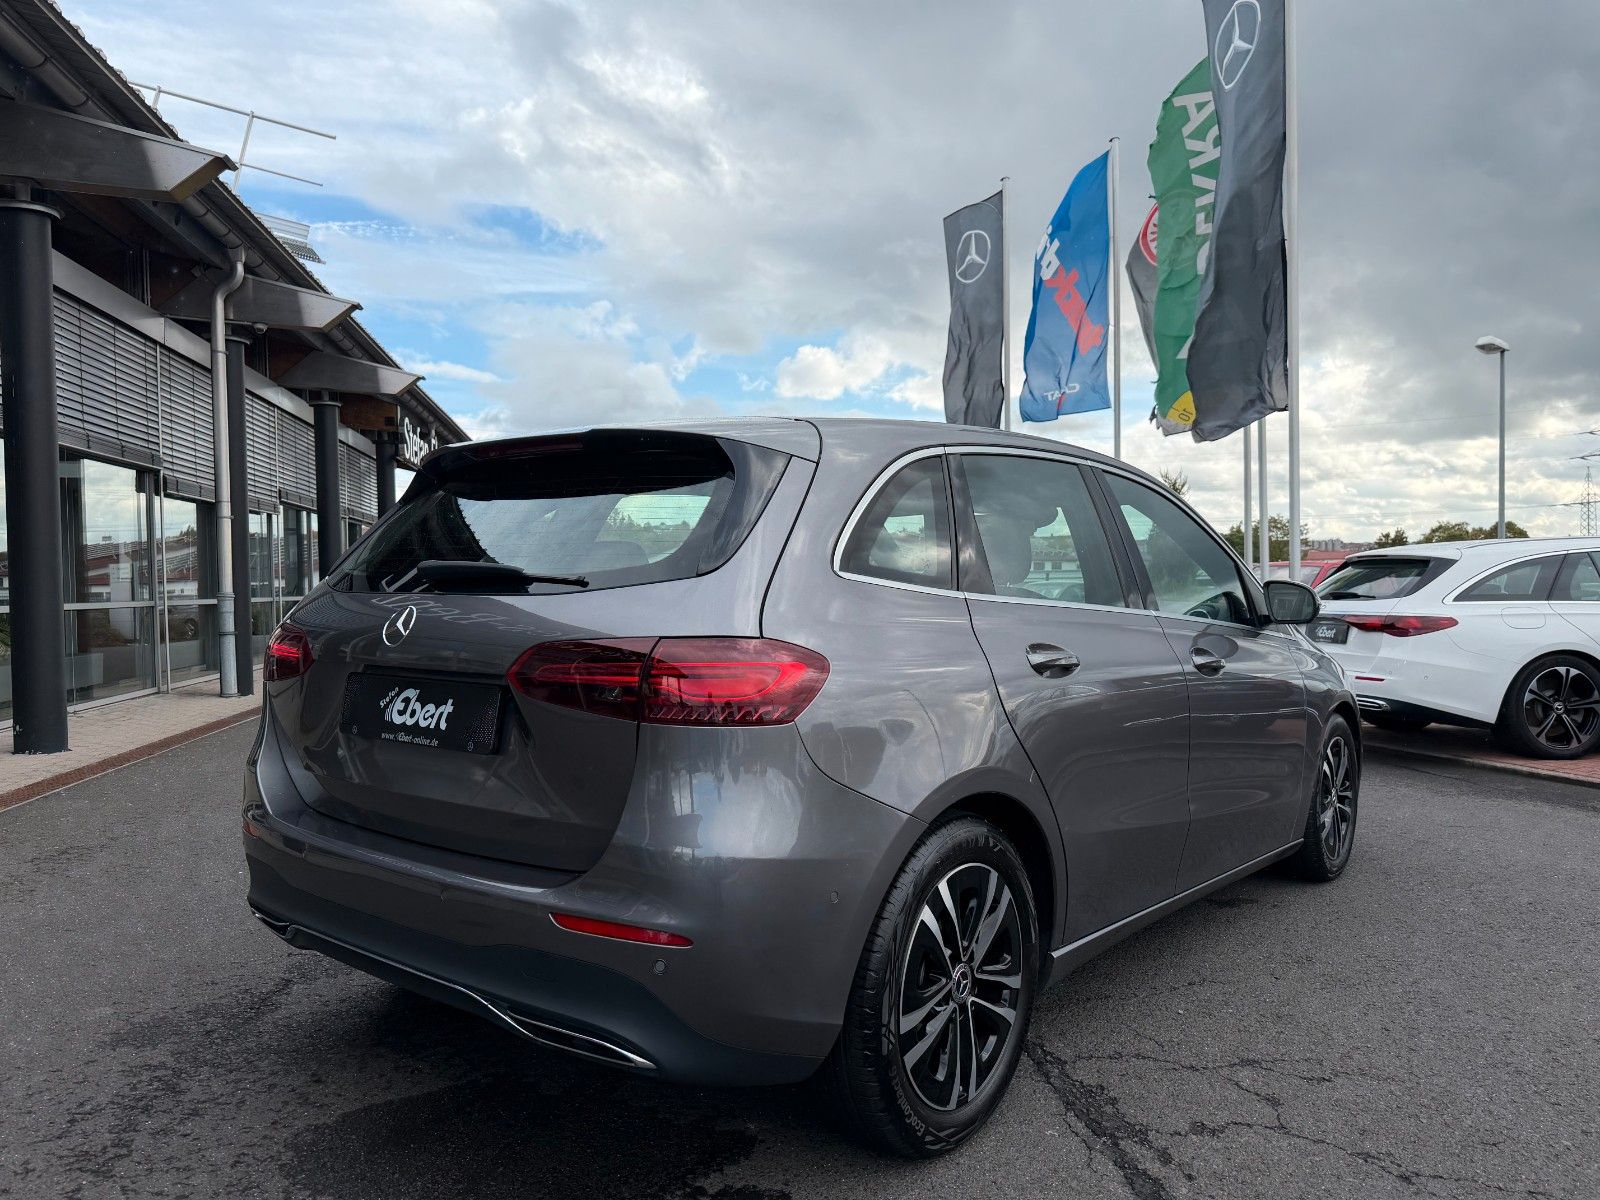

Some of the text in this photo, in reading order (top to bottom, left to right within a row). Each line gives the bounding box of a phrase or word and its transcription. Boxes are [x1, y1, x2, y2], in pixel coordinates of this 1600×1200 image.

[404, 417, 429, 466] Stefan
[379, 687, 399, 708] Stefan
[390, 688, 454, 731] Ebert
